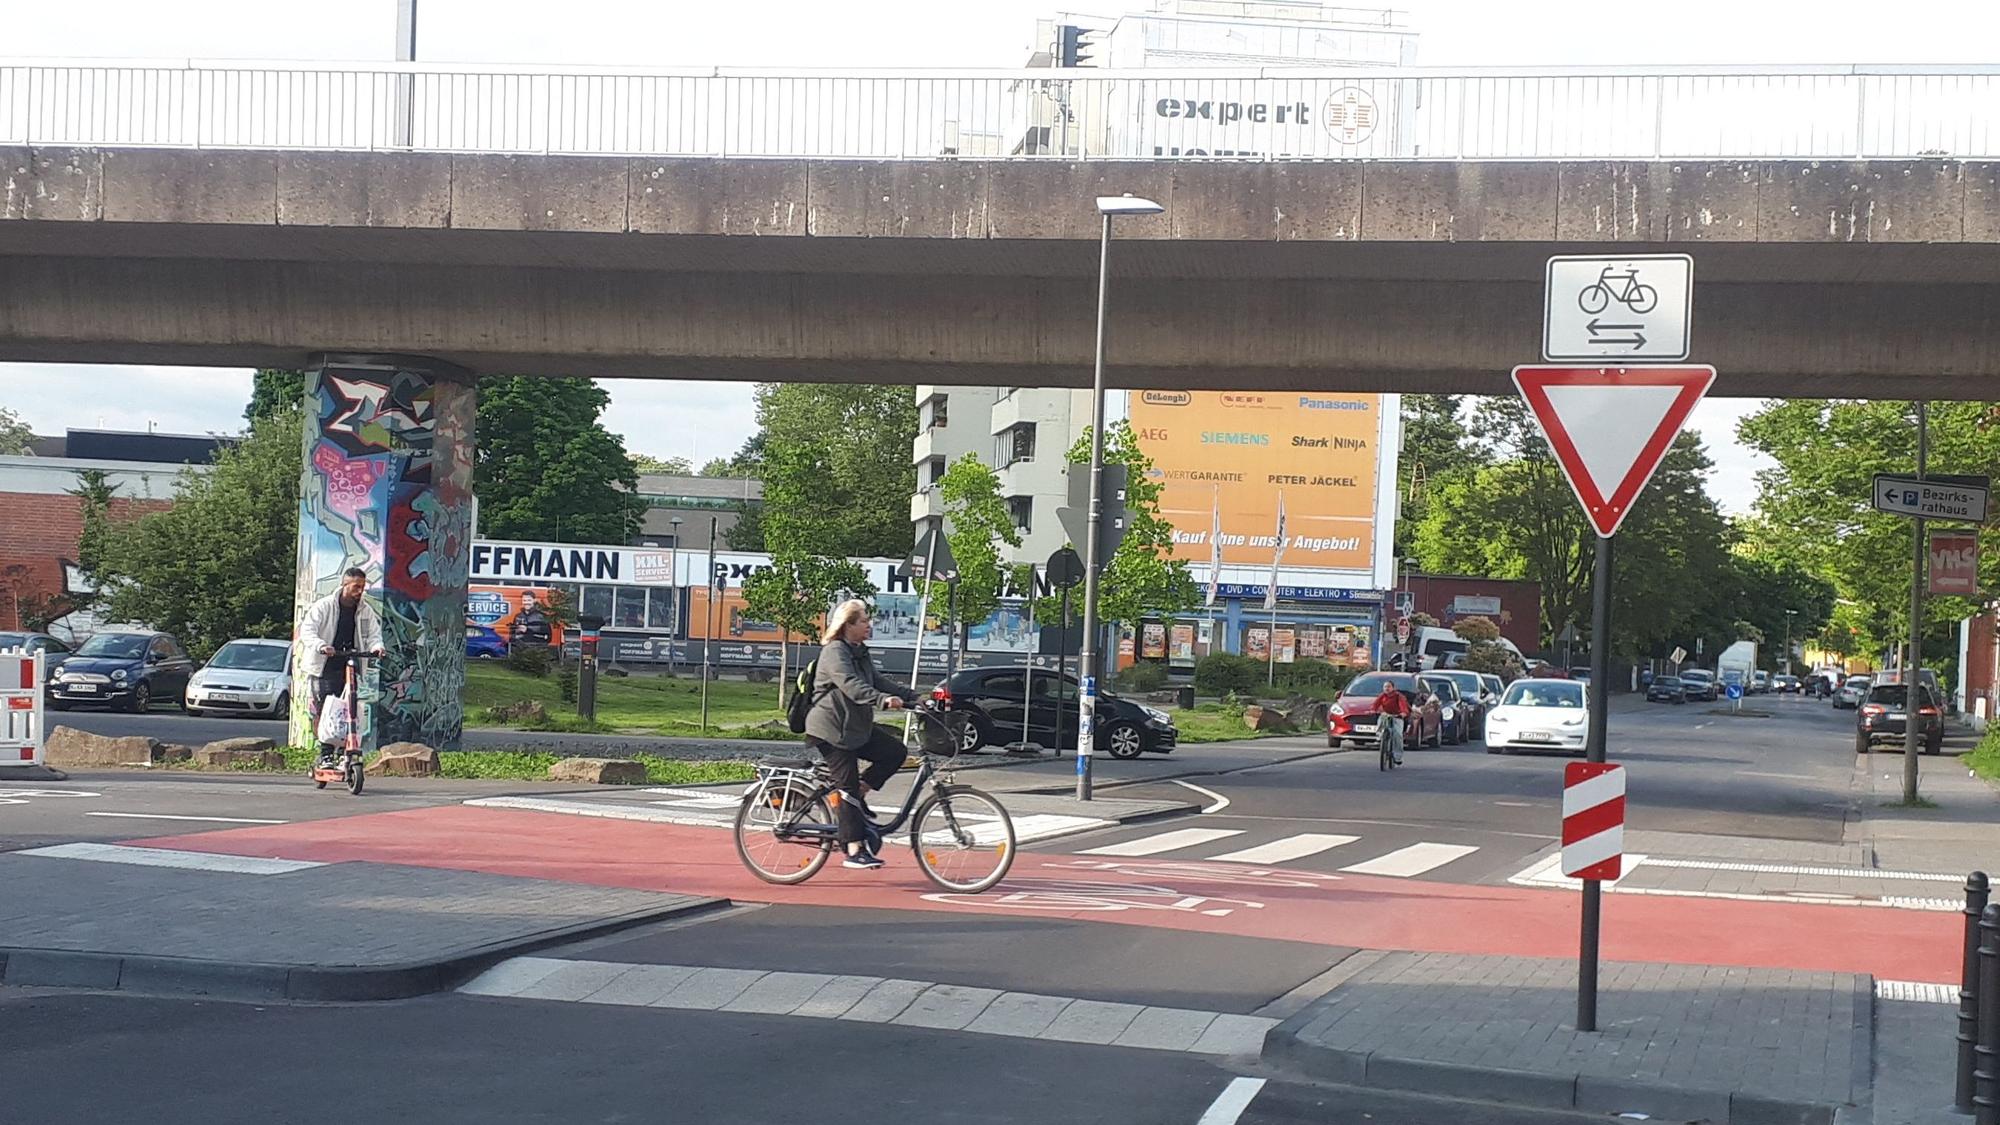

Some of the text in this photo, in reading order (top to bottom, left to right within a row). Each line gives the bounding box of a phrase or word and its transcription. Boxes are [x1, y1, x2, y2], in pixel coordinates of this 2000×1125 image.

[1156, 98, 1310, 126] expert
[1299, 397, 1369, 411] Panasonic
[1139, 428, 1168, 441] AEG
[1200, 431, 1270, 445] SIEMENS
[1291, 435, 1367, 452] Shark NINJA
[1268, 474, 1357, 487] PETER JÄCKEL
[1922, 488, 1975, 503] Bezirks-
[1921, 503, 1968, 515] rathaus
[1172, 529, 1206, 544] Kauf
[1249, 534, 1291, 548] unsr
[1294, 535, 1360, 550] Angebot!
[1931, 546, 1976, 570] VHS
[1226, 585, 1243, 594] DVD
[1251, 586, 1296, 597] COMUTER
[1304, 589, 1341, 599] ELEKTRO
